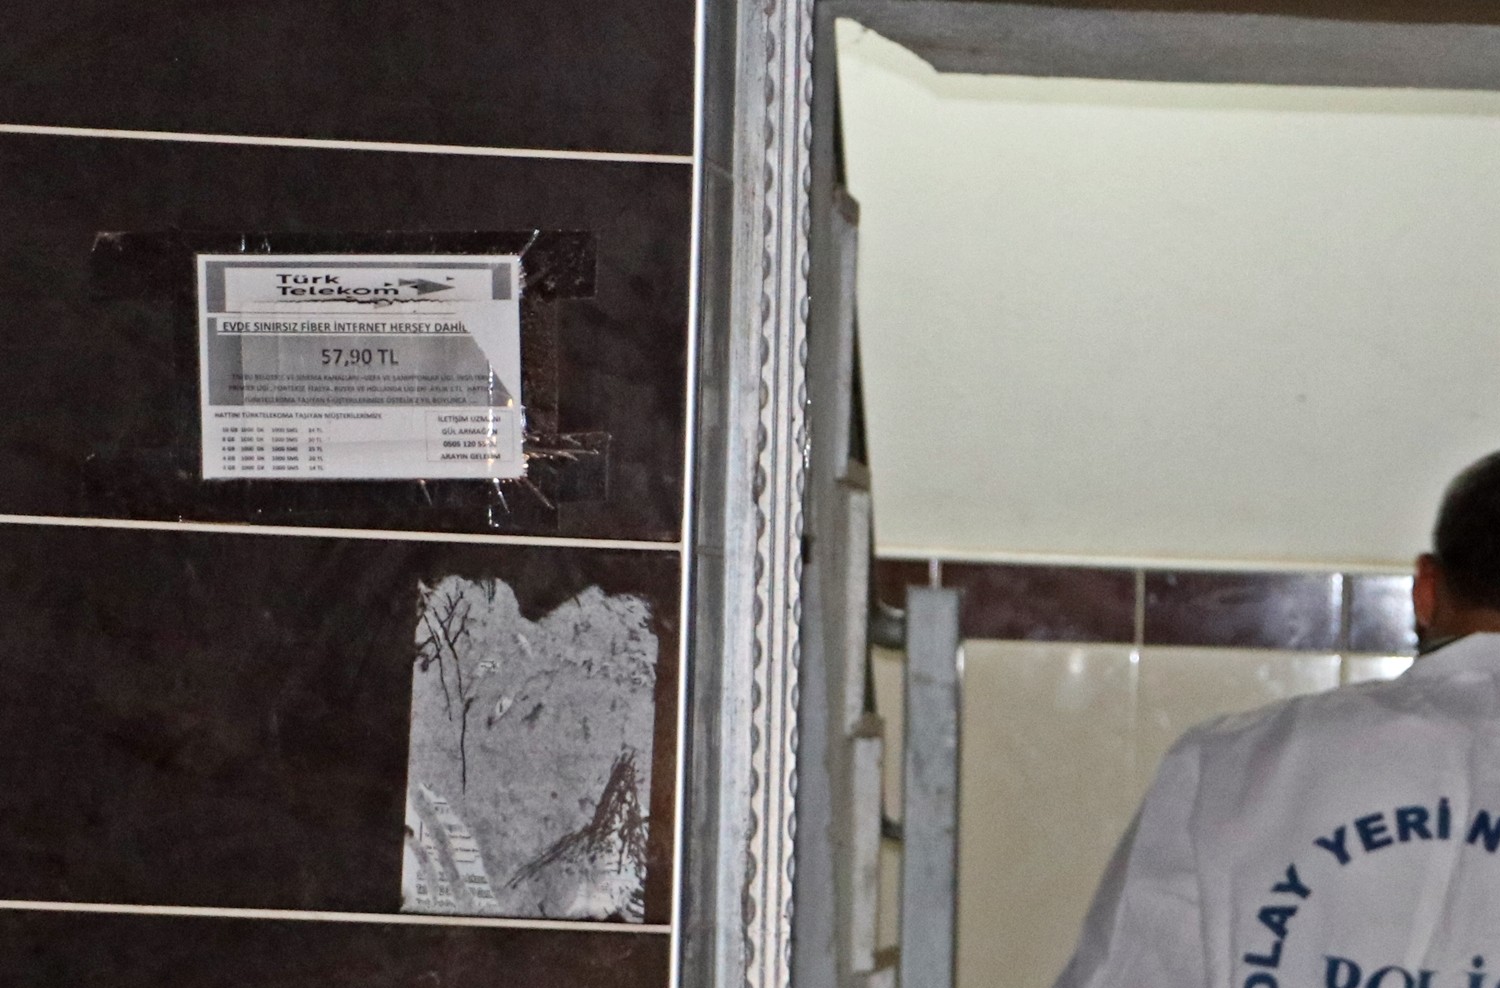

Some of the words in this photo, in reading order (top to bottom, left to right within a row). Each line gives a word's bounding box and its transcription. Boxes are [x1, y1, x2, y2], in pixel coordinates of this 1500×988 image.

[276, 274, 340, 284] Türk
[276, 286, 399, 296] Telekom
[223, 321, 251, 332] EVDE
[254, 321, 298, 332] SINIRSIZ
[301, 320, 331, 332] FİBER
[334, 320, 387, 332] İNTERNET
[321, 349, 371, 366] 57,90
[378, 349, 399, 365] TL
